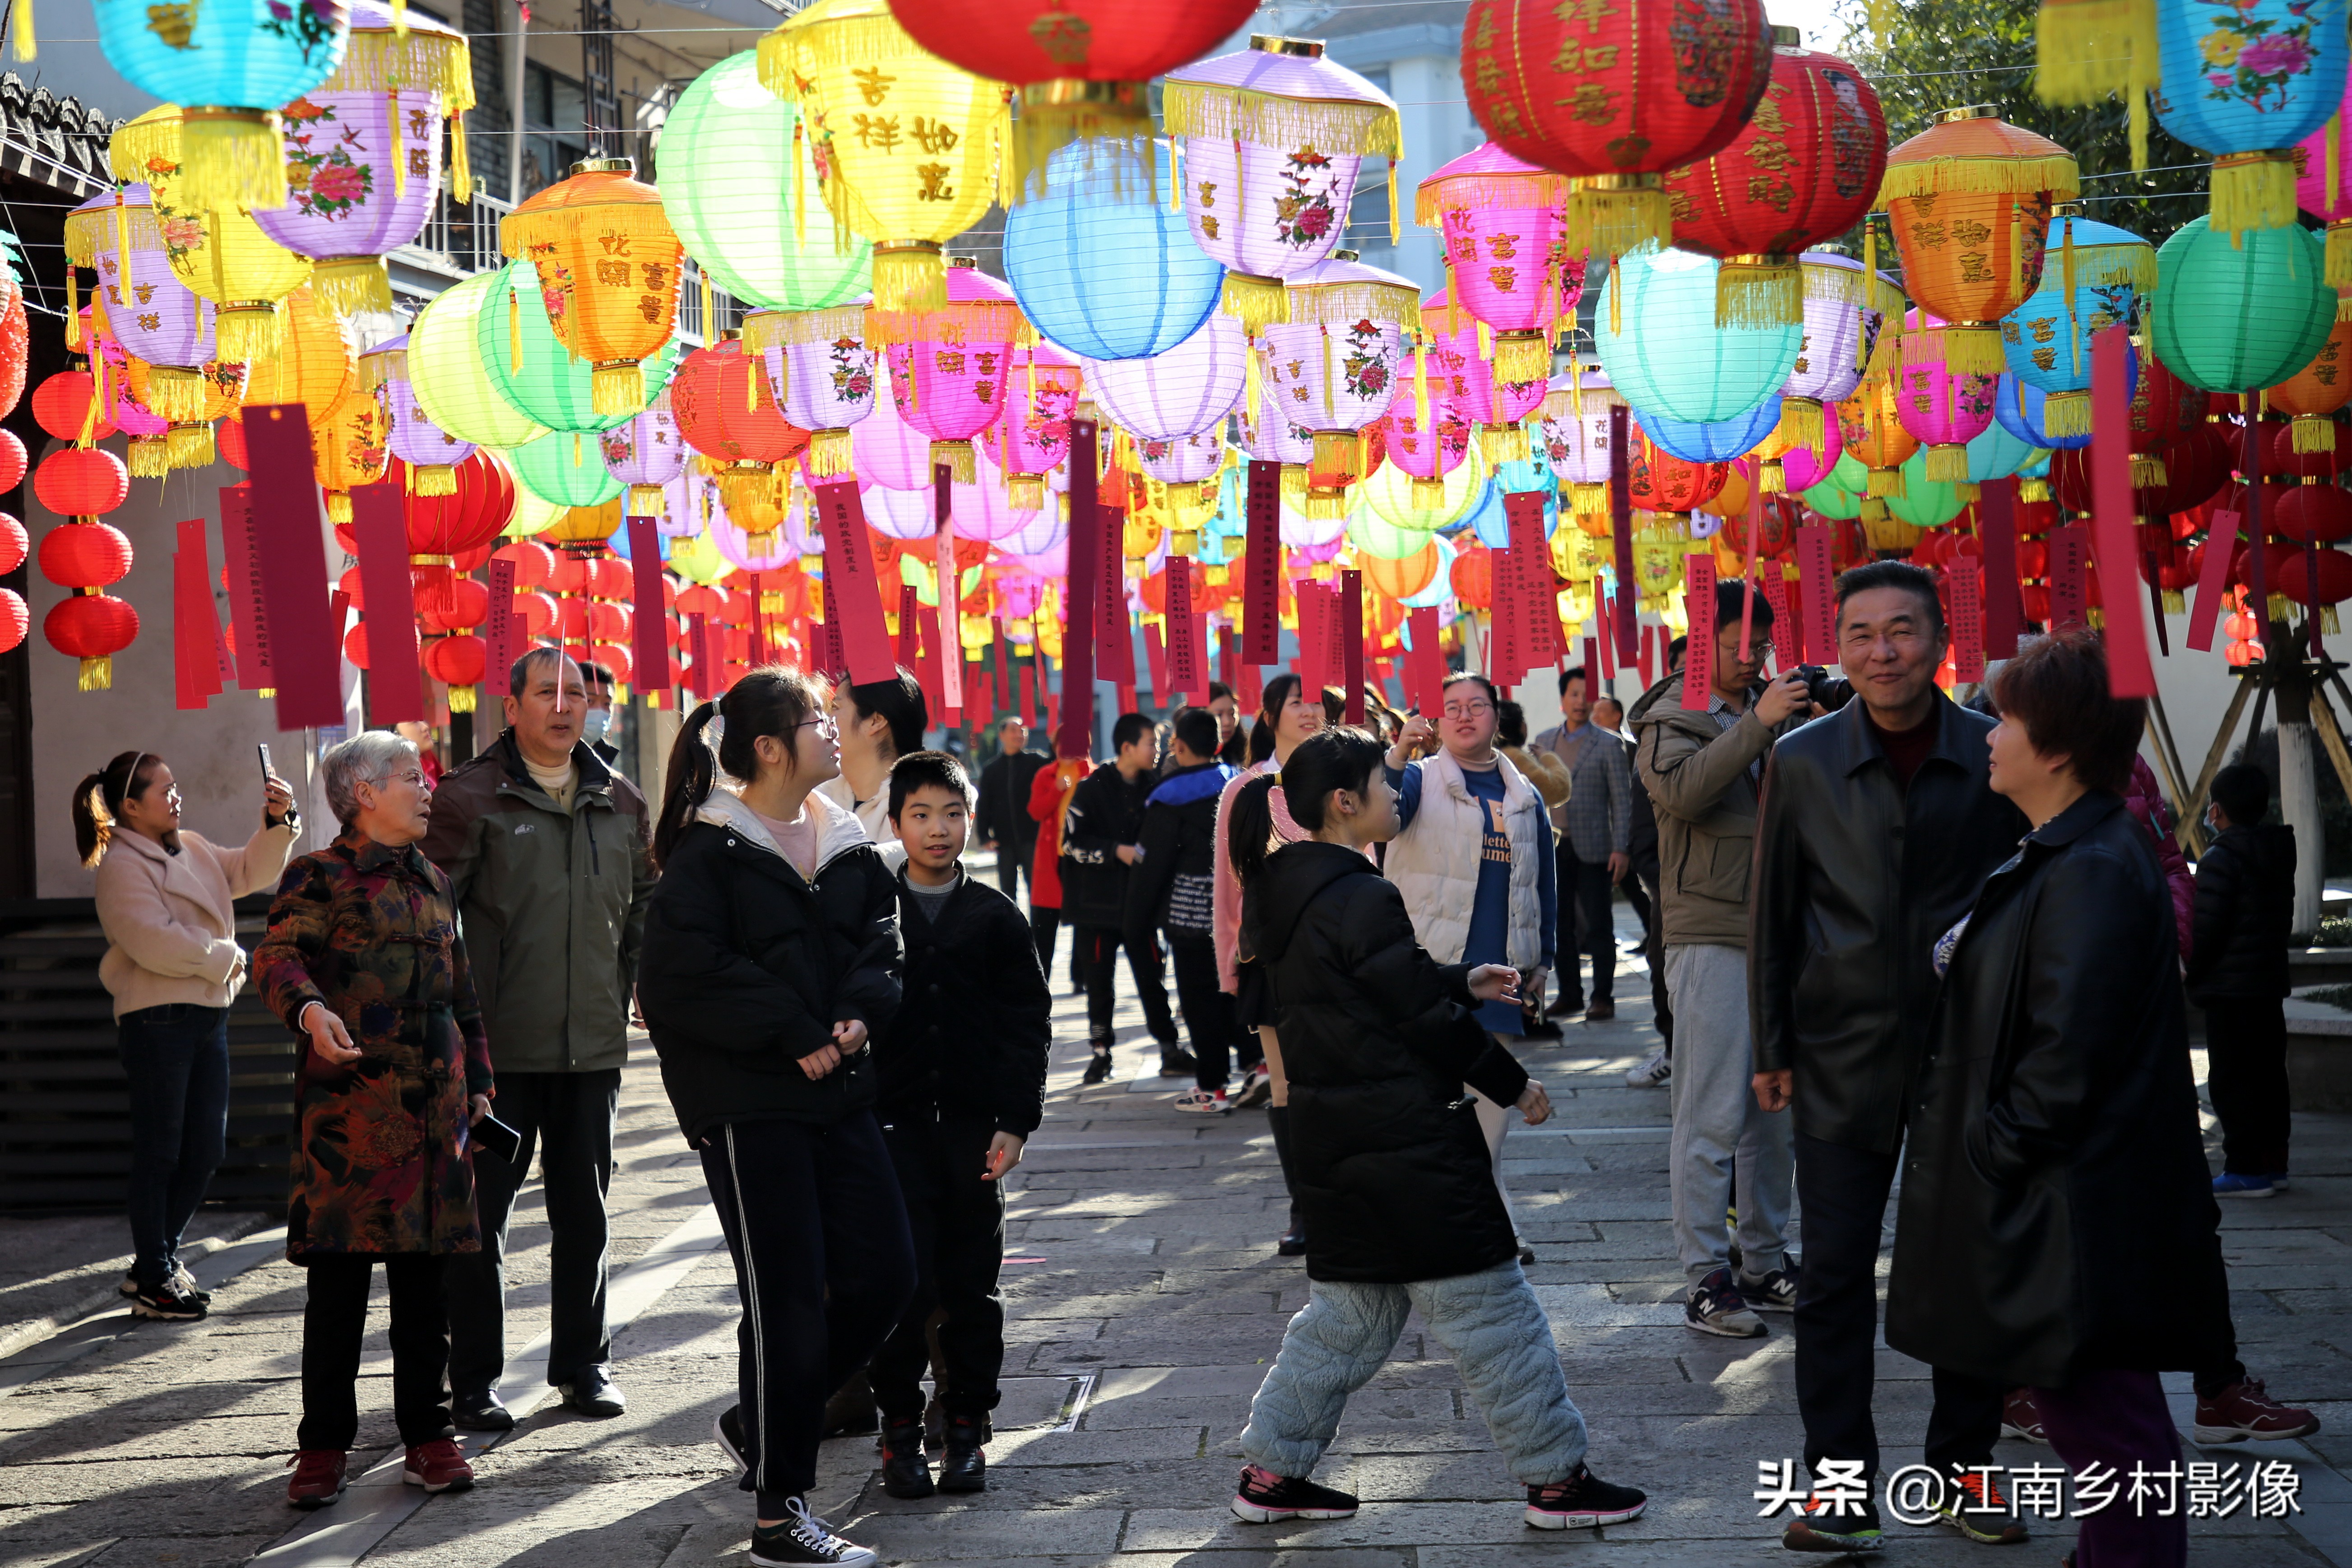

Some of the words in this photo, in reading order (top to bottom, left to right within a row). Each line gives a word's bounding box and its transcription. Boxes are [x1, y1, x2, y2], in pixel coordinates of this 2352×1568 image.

[852, 66, 903, 155] 吉祥
[911, 116, 959, 202] 如意
[1951, 219, 1995, 283] 如意
[133, 283, 162, 332] 吉祥
[1287, 359, 1311, 403] 吉祥
[1699, 1299, 1715, 1315] N
[1772, 1278, 1794, 1294] N
